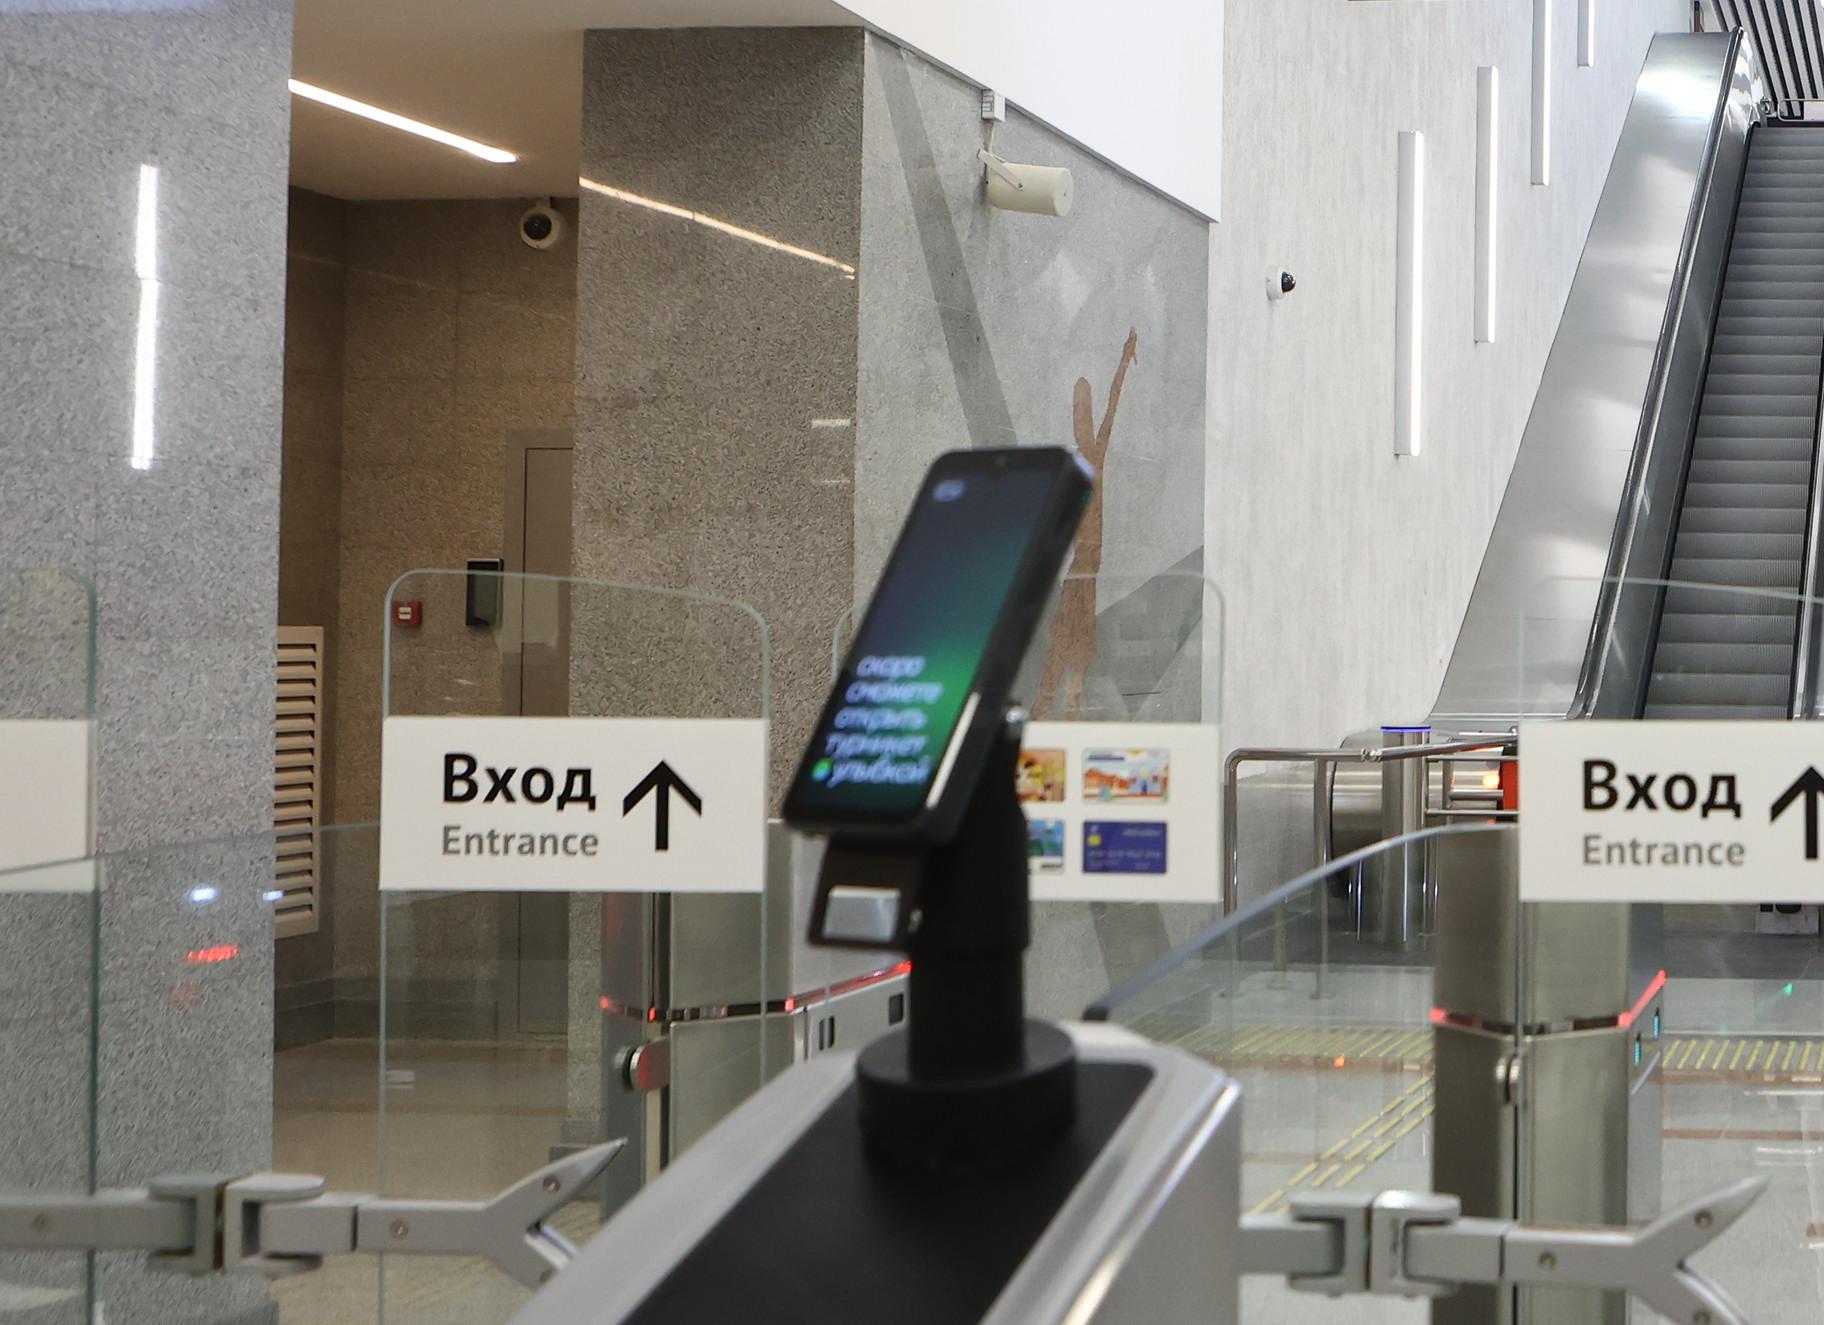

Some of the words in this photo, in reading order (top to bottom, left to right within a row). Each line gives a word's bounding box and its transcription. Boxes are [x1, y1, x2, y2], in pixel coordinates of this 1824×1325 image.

[857, 656, 926, 681] скоро
[845, 682, 943, 703] сможете
[834, 707, 927, 735] открыть
[825, 734, 929, 759] турникет
[443, 753, 596, 812] Вход
[827, 756, 932, 787] улыбкой
[1583, 760, 1741, 818] Вход
[443, 825, 599, 856] Entrance
[1583, 834, 1746, 866] Entrance
